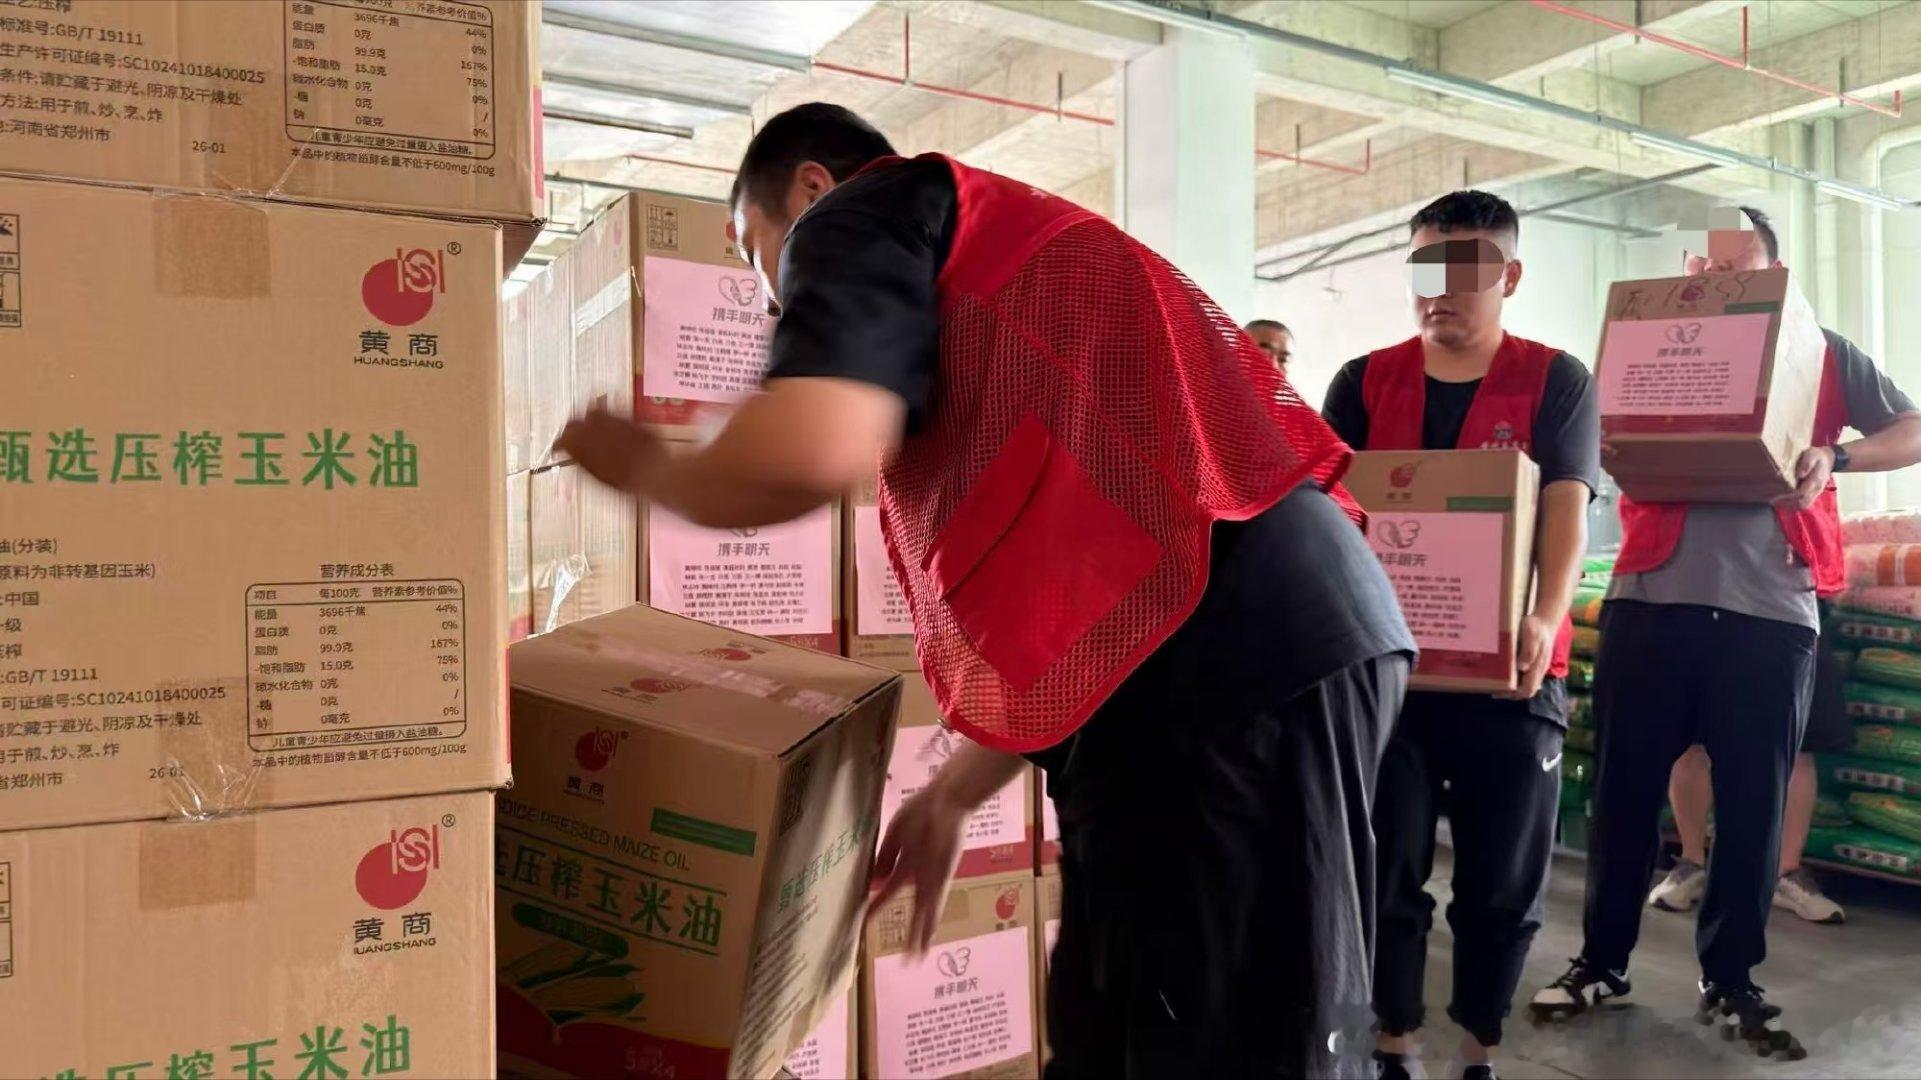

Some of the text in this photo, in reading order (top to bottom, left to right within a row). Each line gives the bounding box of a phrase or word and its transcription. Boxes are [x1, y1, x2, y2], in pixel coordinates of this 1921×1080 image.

[98, 28, 143, 46] 19111
[354, 29, 371, 40] 0克
[471, 45, 487, 56] 0%
[354, 47, 386, 60] 99.9克
[355, 63, 387, 77] 15.0克
[355, 81, 373, 93] 0克
[355, 98, 373, 110] 0克
[191, 140, 227, 154] 26-01
[712, 307, 765, 327] 携手明天
[359, 330, 439, 357] 黄商
[354, 356, 444, 370] HUANGSHANG
[717, 542, 770, 557] 携手明天
[320, 563, 394, 579] 营养成分表
[254, 590, 277, 600] 项目
[319, 587, 360, 600] 每100克
[254, 603, 458, 621] 能量 3696千焦 44%
[0, 617, 22, 633] 级
[319, 624, 338, 636] 0克
[441, 620, 459, 631] 0%
[254, 638, 460, 657] 脂肪 99.9克 167%
[319, 659, 354, 672] 15.0克
[436, 654, 460, 665] 75%
[52, 667, 99, 683] 19111
[319, 677, 339, 690] 0克
[442, 672, 460, 683] 0%
[320, 695, 340, 707] 0克
[442, 705, 460, 717] 0%
[0, 710, 202, 738] 贮藏于避光、阴凉及干燥处
[0, 741, 120, 765] 于煎、炒、烹、炸
[613, 835, 662, 864] MAIZE
[664, 850, 691, 872] OIL
[353, 911, 433, 943] 黄商
